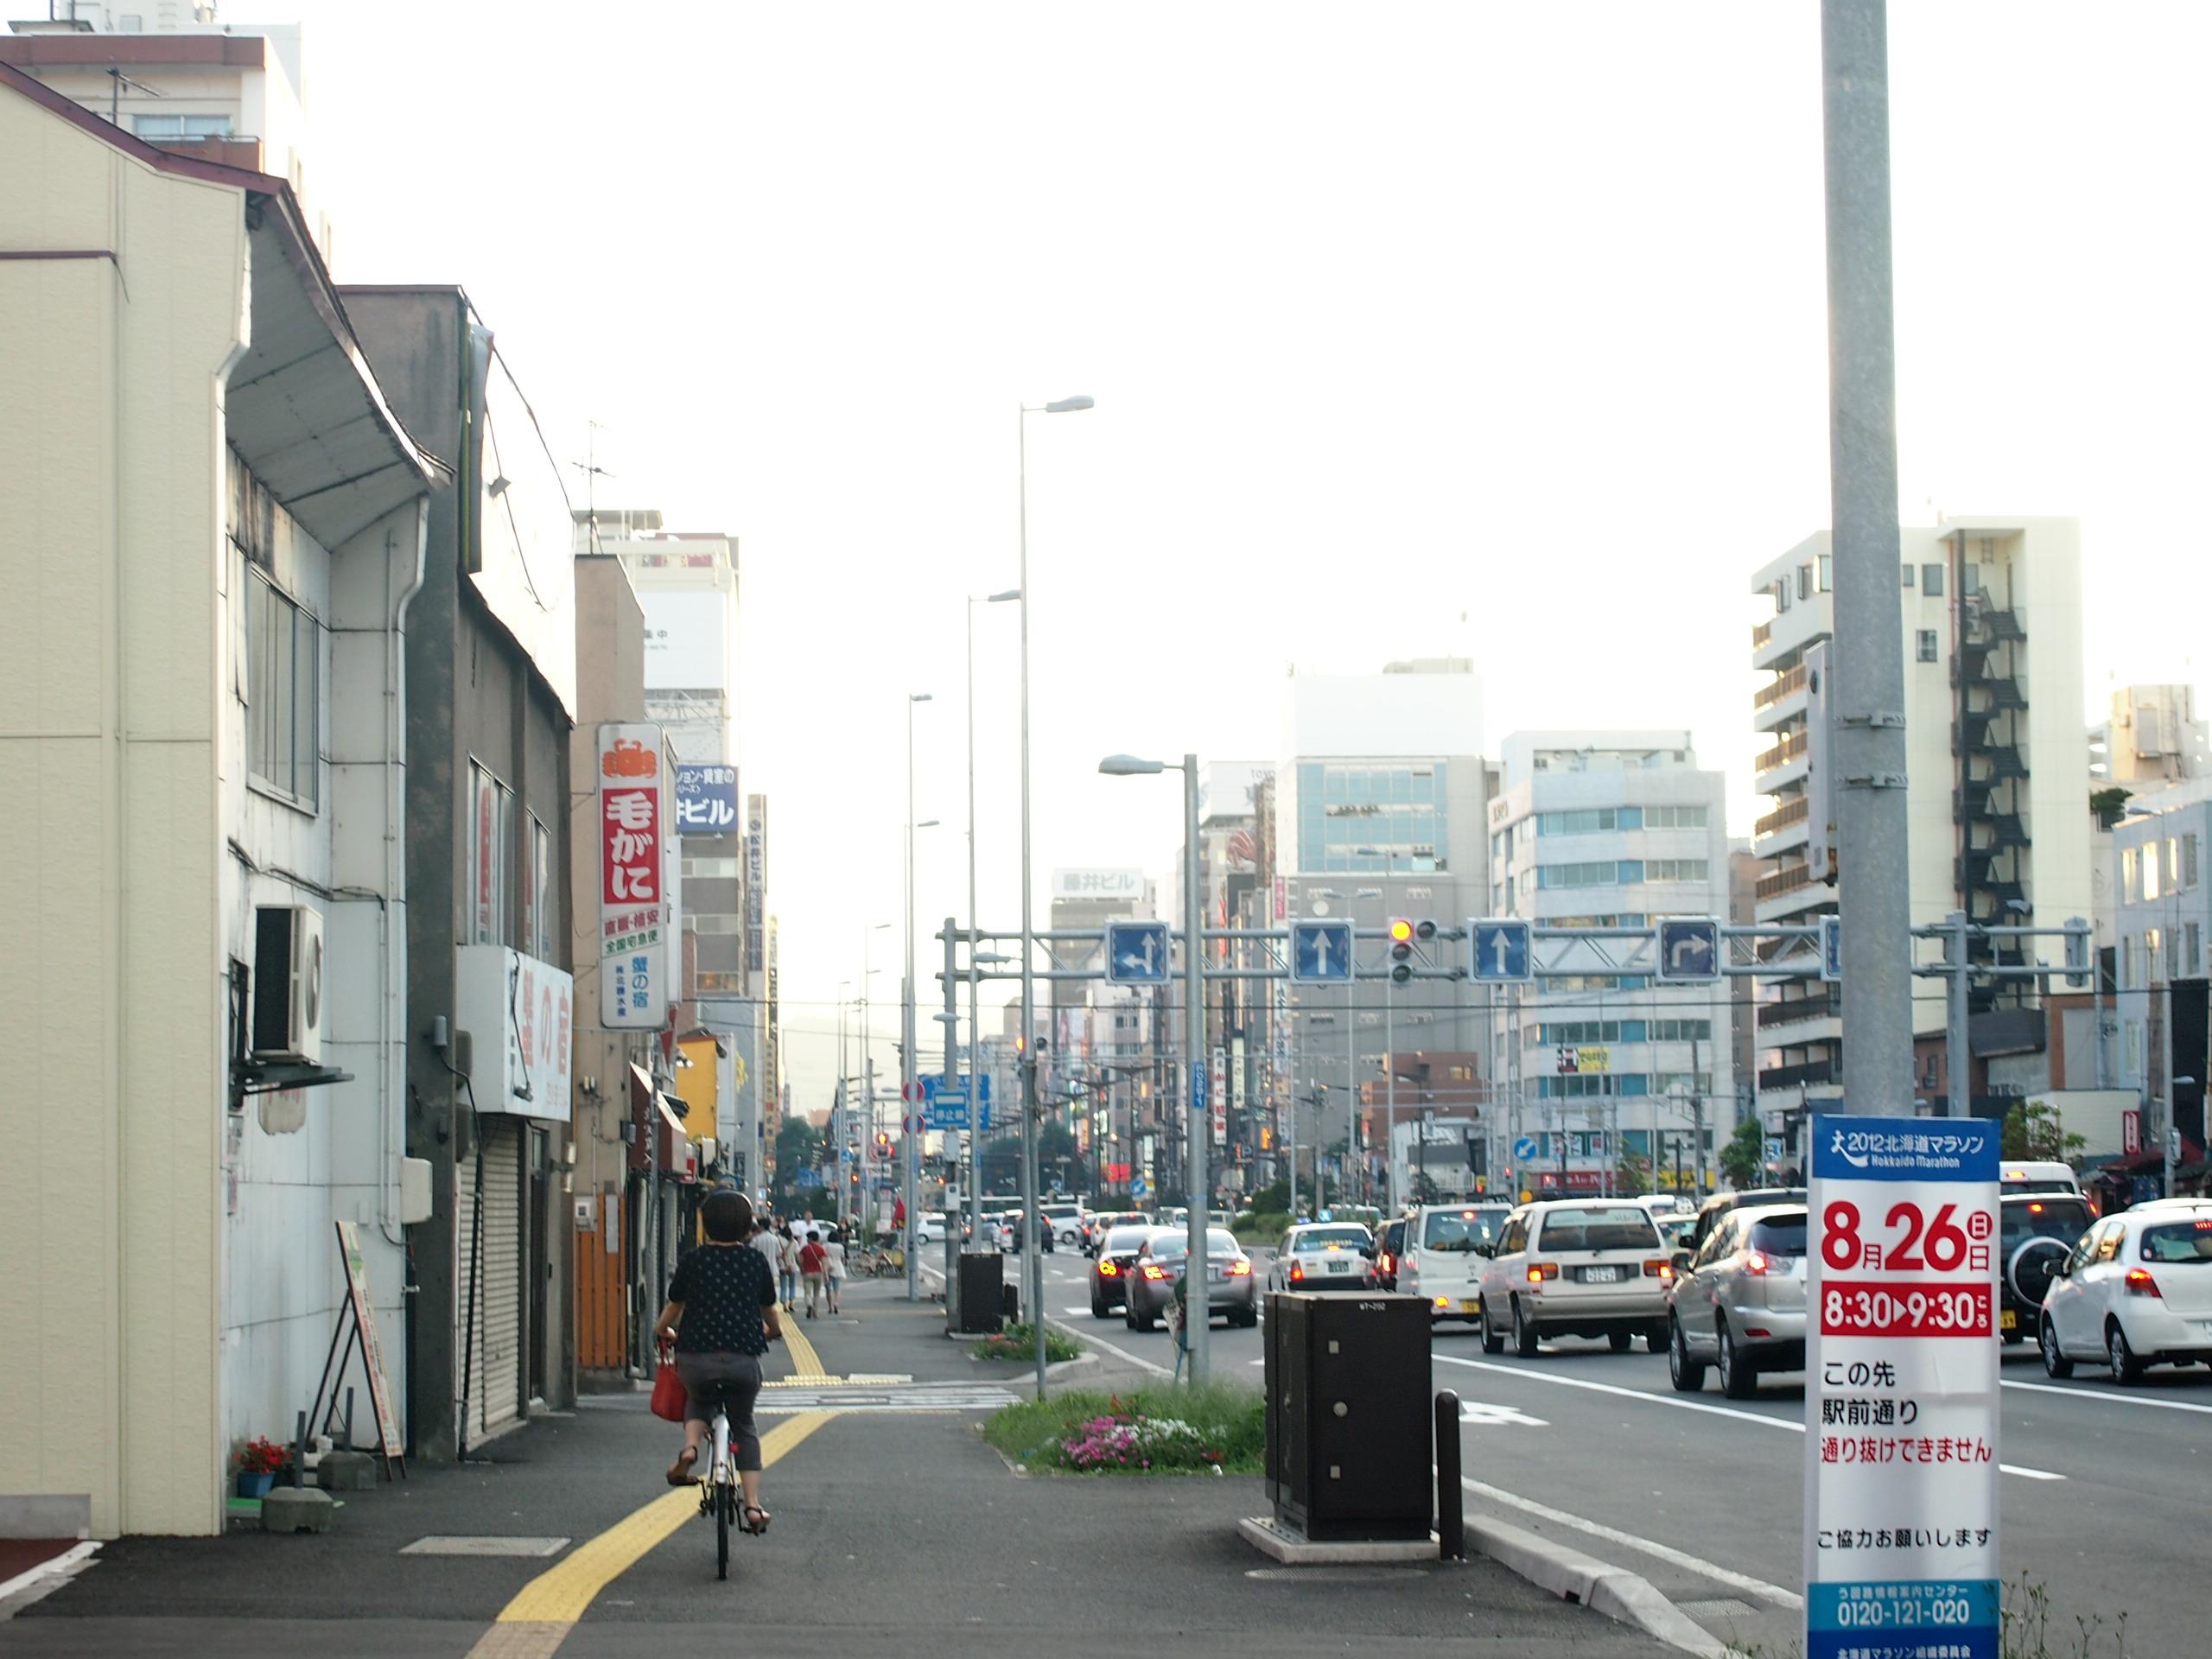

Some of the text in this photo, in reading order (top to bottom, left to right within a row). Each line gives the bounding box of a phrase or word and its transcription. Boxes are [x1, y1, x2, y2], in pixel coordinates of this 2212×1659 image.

[607, 791, 654, 899] 毛がに
[607, 930, 658, 954] 全国宅急便
[1847, 1132, 1985, 1154] 2012北海道マラソン
[1872, 1154, 1961, 1169] Hokkaido Marathon
[1825, 1360, 1896, 1387] この先
[1822, 1399, 1918, 1426] 駅前通り
[1821, 1436, 1993, 1463] 通り抜けできません
[1818, 1528, 1993, 1549] ご協力お願いします
[1838, 1599, 1970, 1626] 0120-121-020
